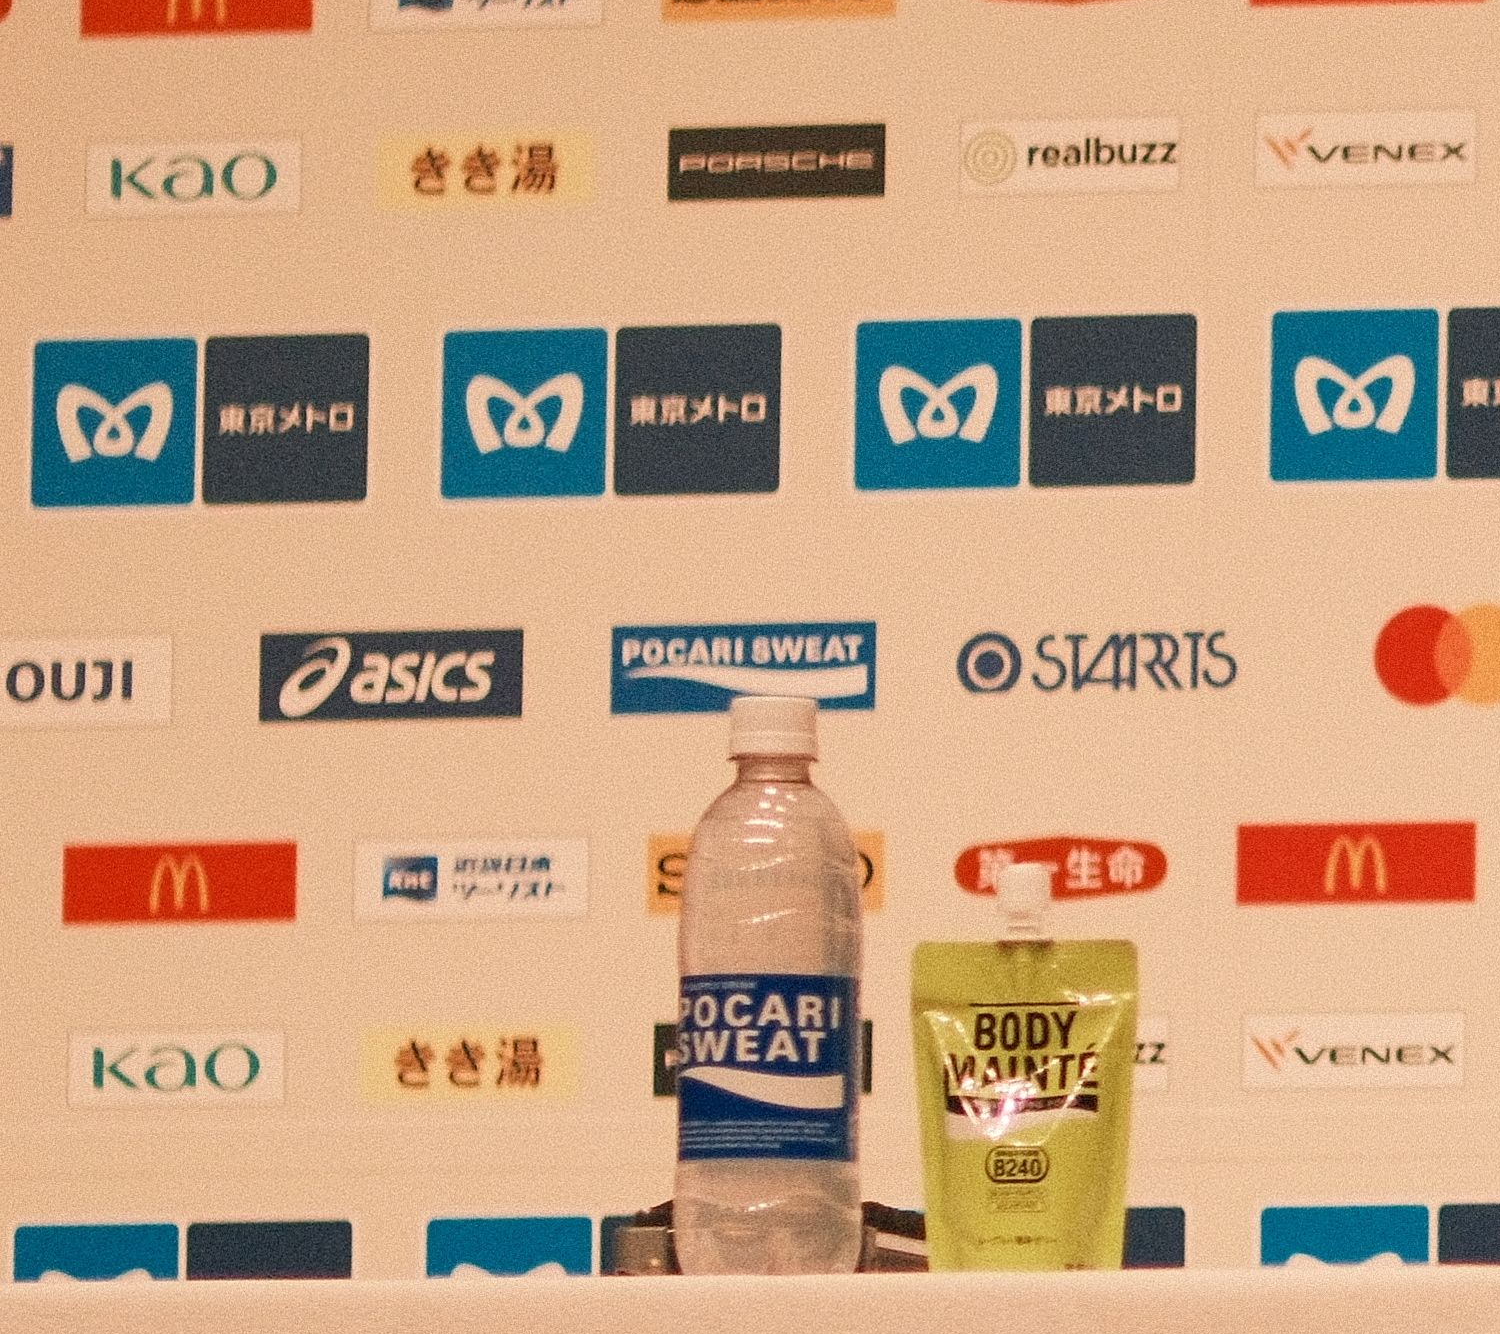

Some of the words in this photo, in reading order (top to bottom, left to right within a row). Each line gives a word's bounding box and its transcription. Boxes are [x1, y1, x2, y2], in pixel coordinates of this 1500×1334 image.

[1028, 137, 1176, 166] realbuzz
[1308, 144, 1464, 163] VENEX
[1046, 385, 1182, 414] 東京メトロ
[220, 404, 354, 433] 東京メトロ
[623, 639, 746, 668] POCARI
[753, 636, 861, 663] SWEAT
[6, 660, 132, 703] OUJI
[351, 652, 494, 702] asics
[977, 848, 1145, 892] 第生命
[679, 1029, 826, 1065] SWEAT
[974, 1011, 1077, 1051] BODY
[1295, 1046, 1452, 1065] VENEX
